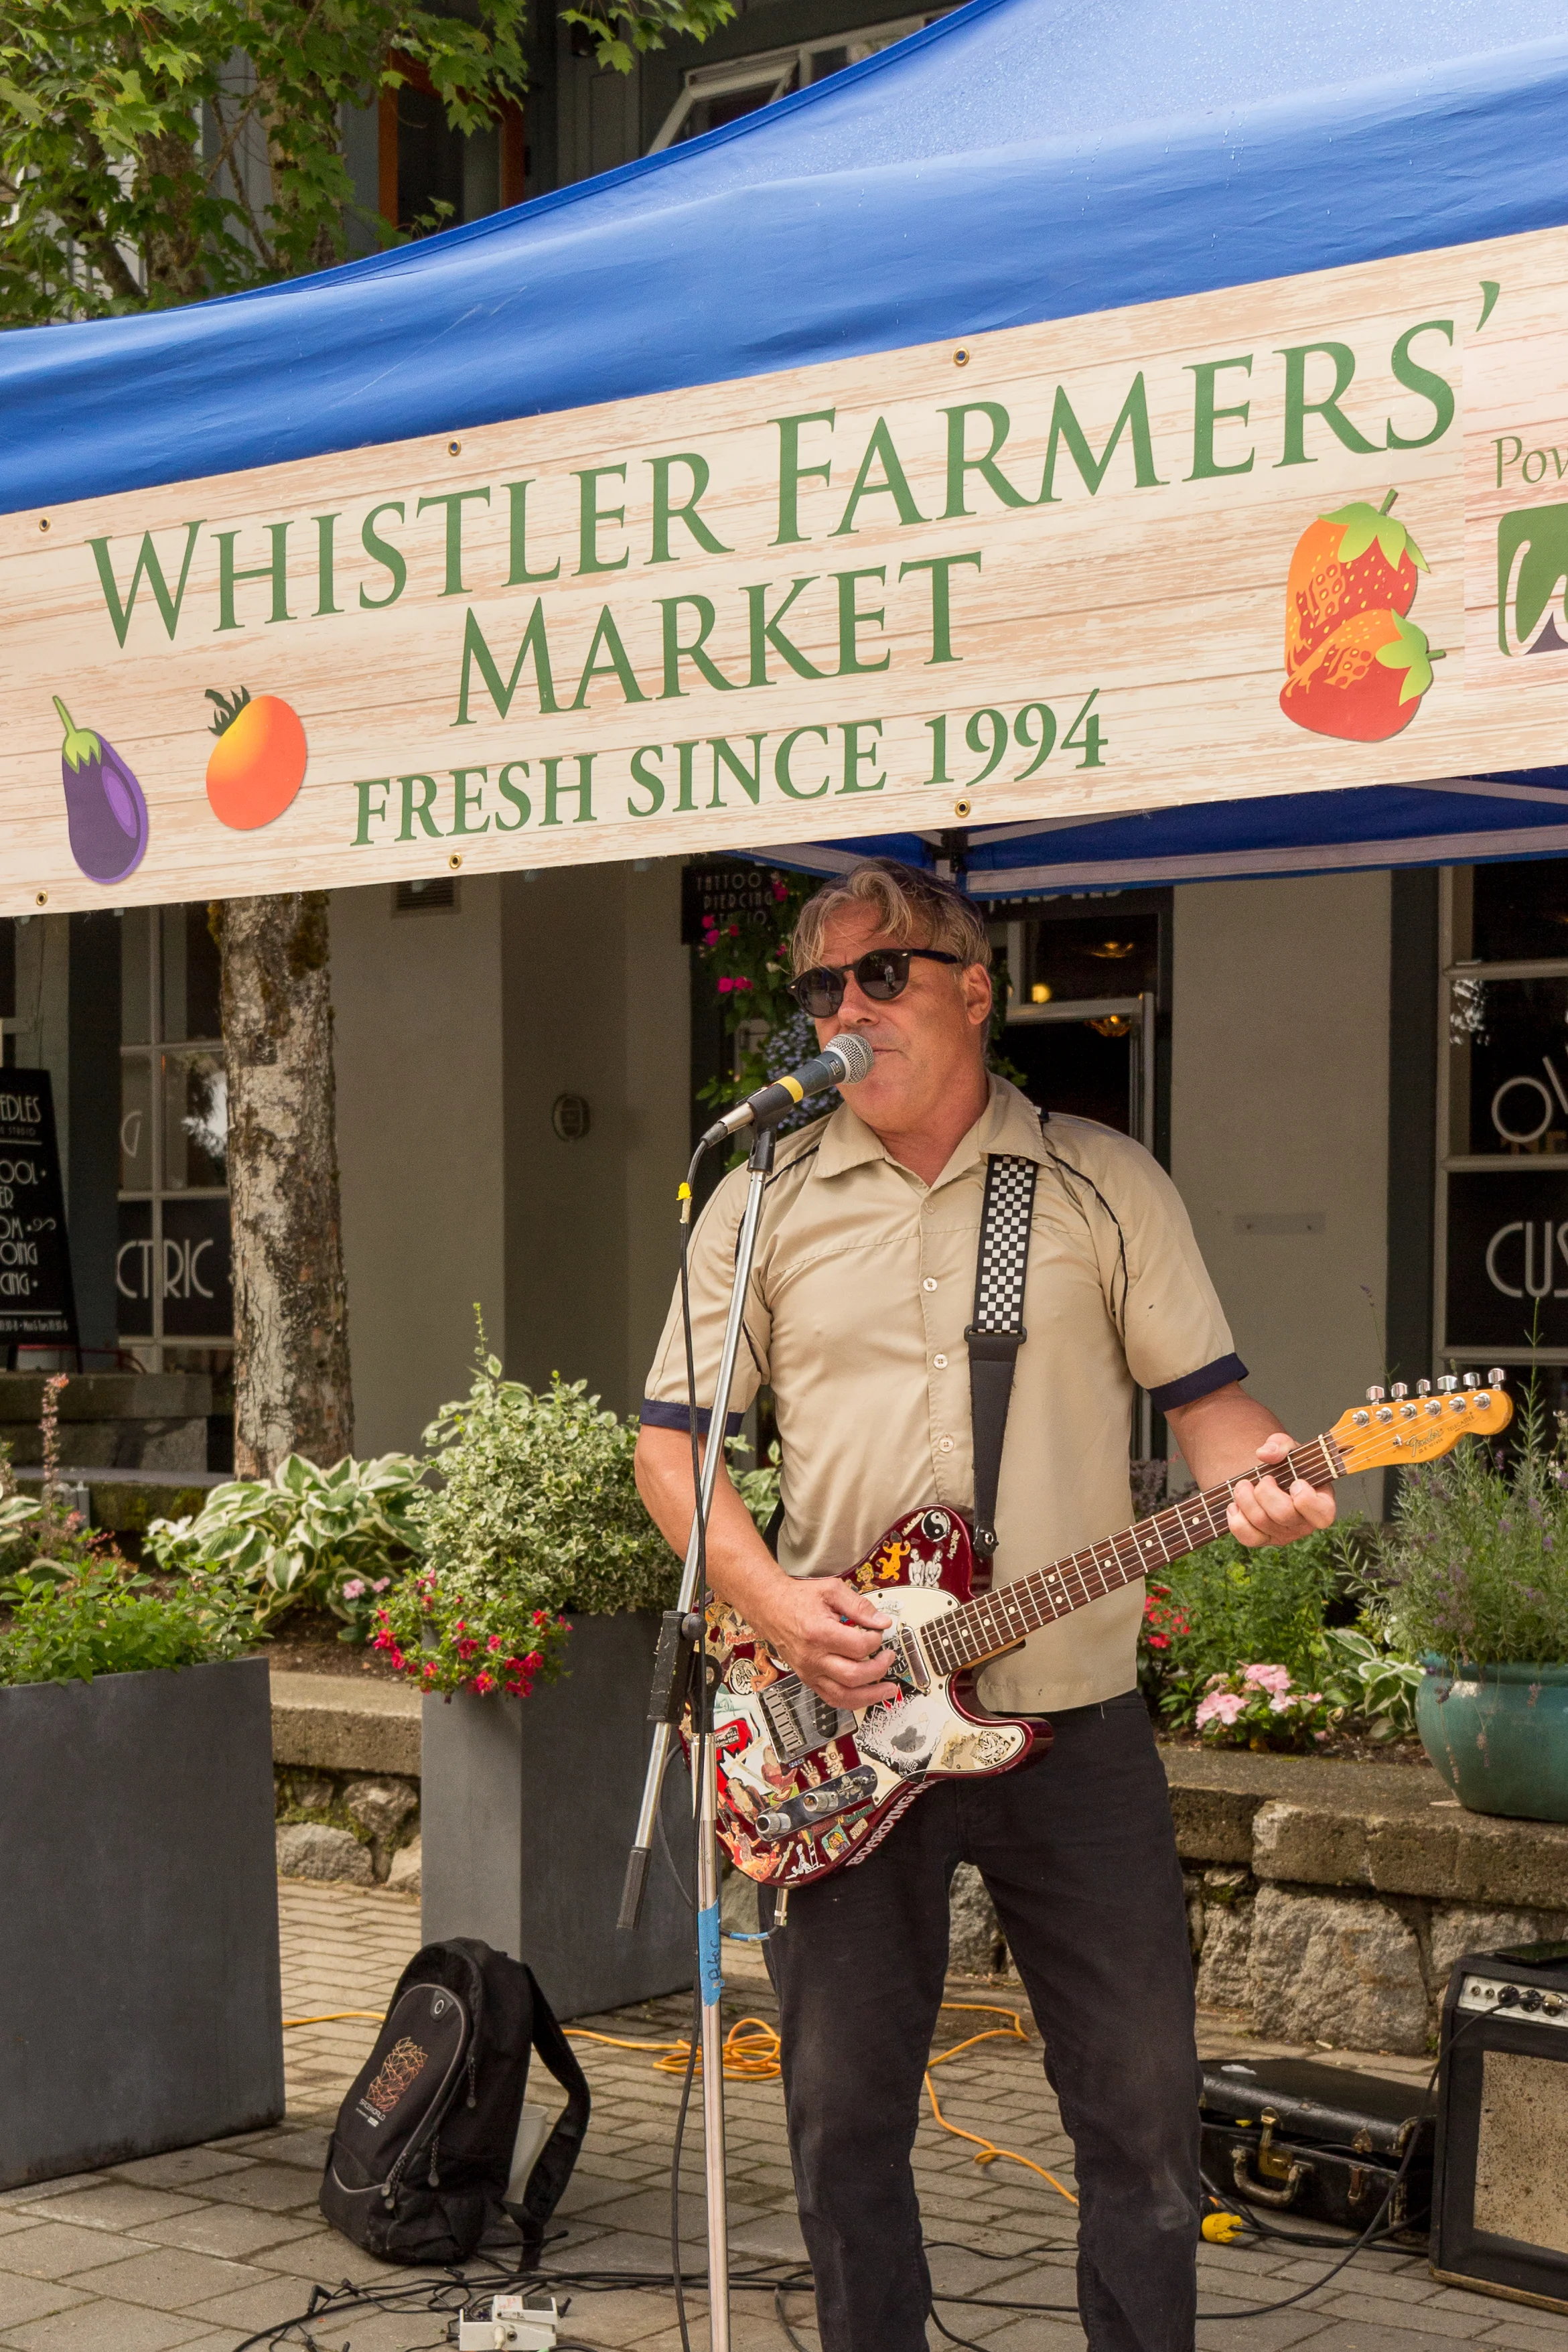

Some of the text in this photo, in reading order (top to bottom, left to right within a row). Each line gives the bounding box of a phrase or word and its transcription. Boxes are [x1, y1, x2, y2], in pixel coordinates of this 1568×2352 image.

[84, 453, 735, 648] WHISTLER
[449, 551, 981, 727] MARKET
[350, 689, 1109, 847] FRESH SINCE 1994
[1405, 1428, 1441, 1458] Fender
[845, 1795, 916, 1866] BOARDING
